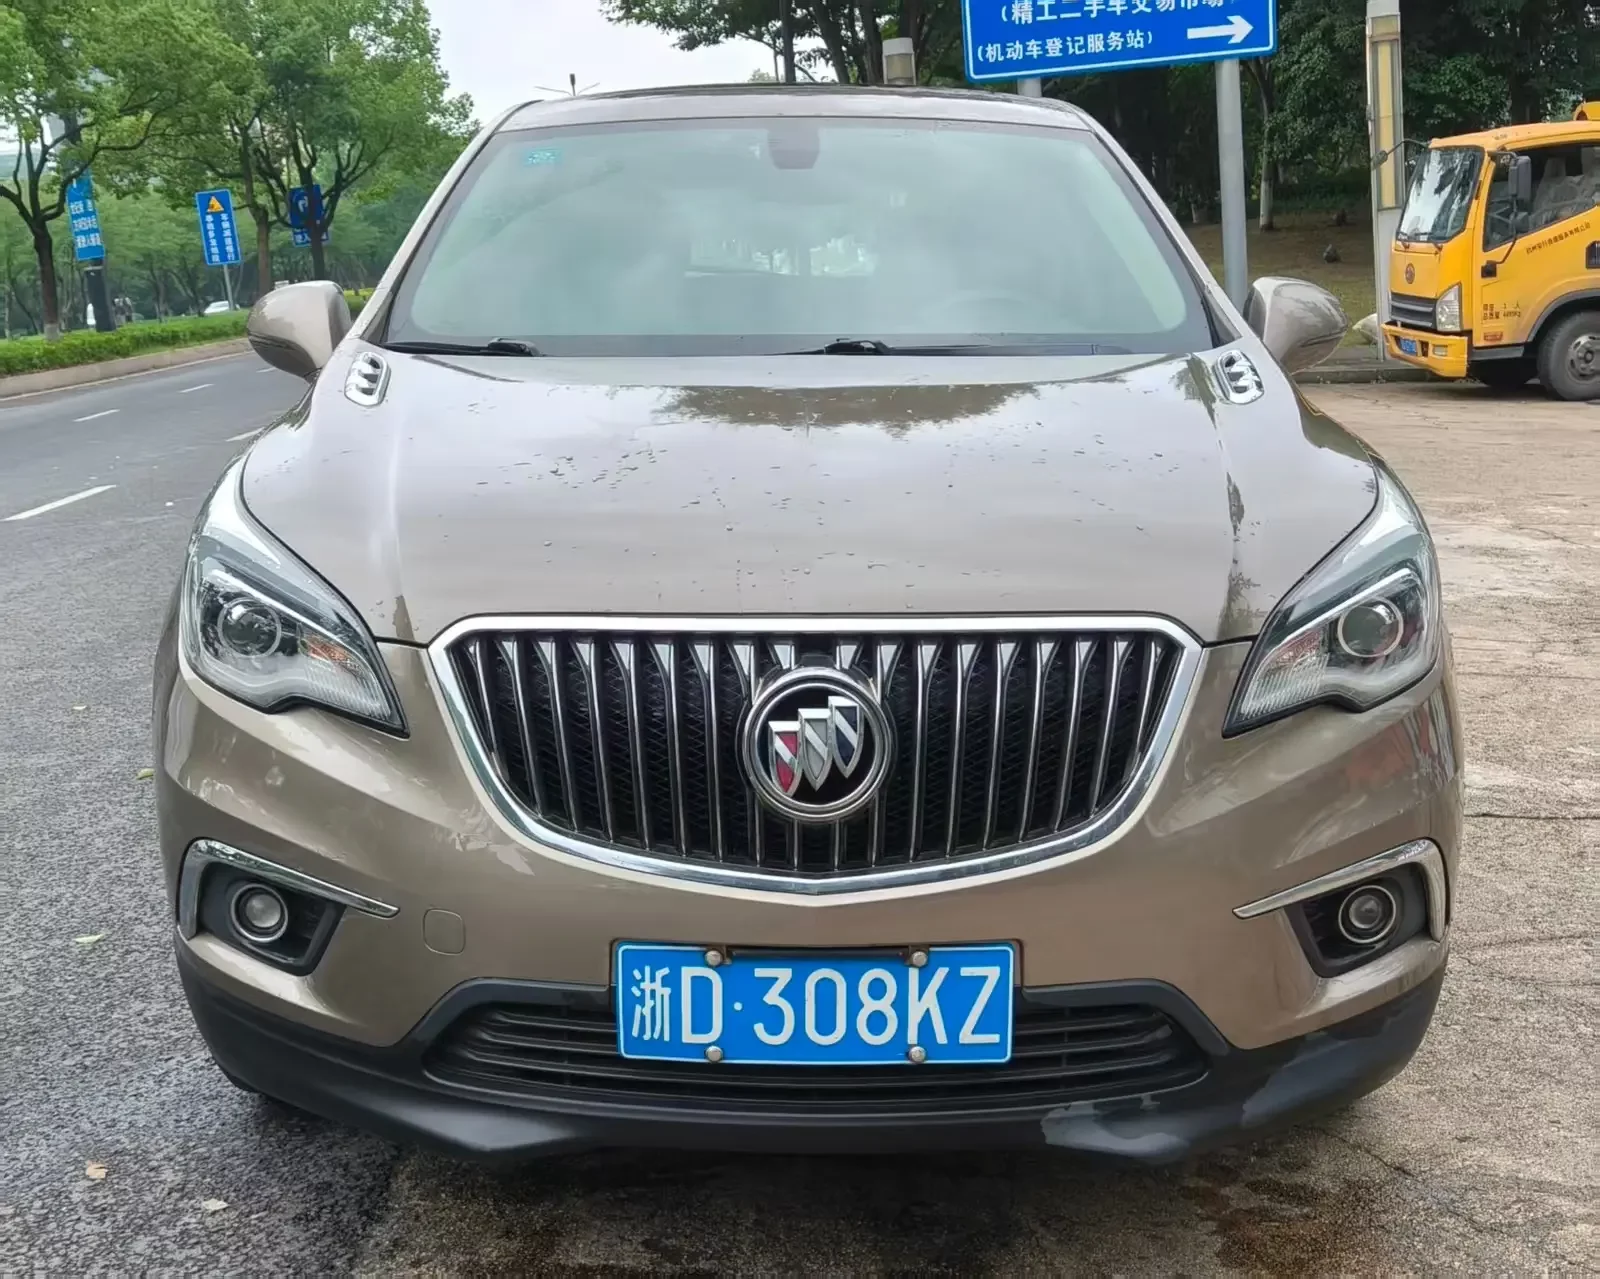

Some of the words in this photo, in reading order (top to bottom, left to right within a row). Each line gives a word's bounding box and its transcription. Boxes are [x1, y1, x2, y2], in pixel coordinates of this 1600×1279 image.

[1001, 0, 1234, 25] (精工二手车交
[977, 29, 1154, 62] (机动车登记服务站)
[631, 965, 1001, 1046] 浙D·308KZ
